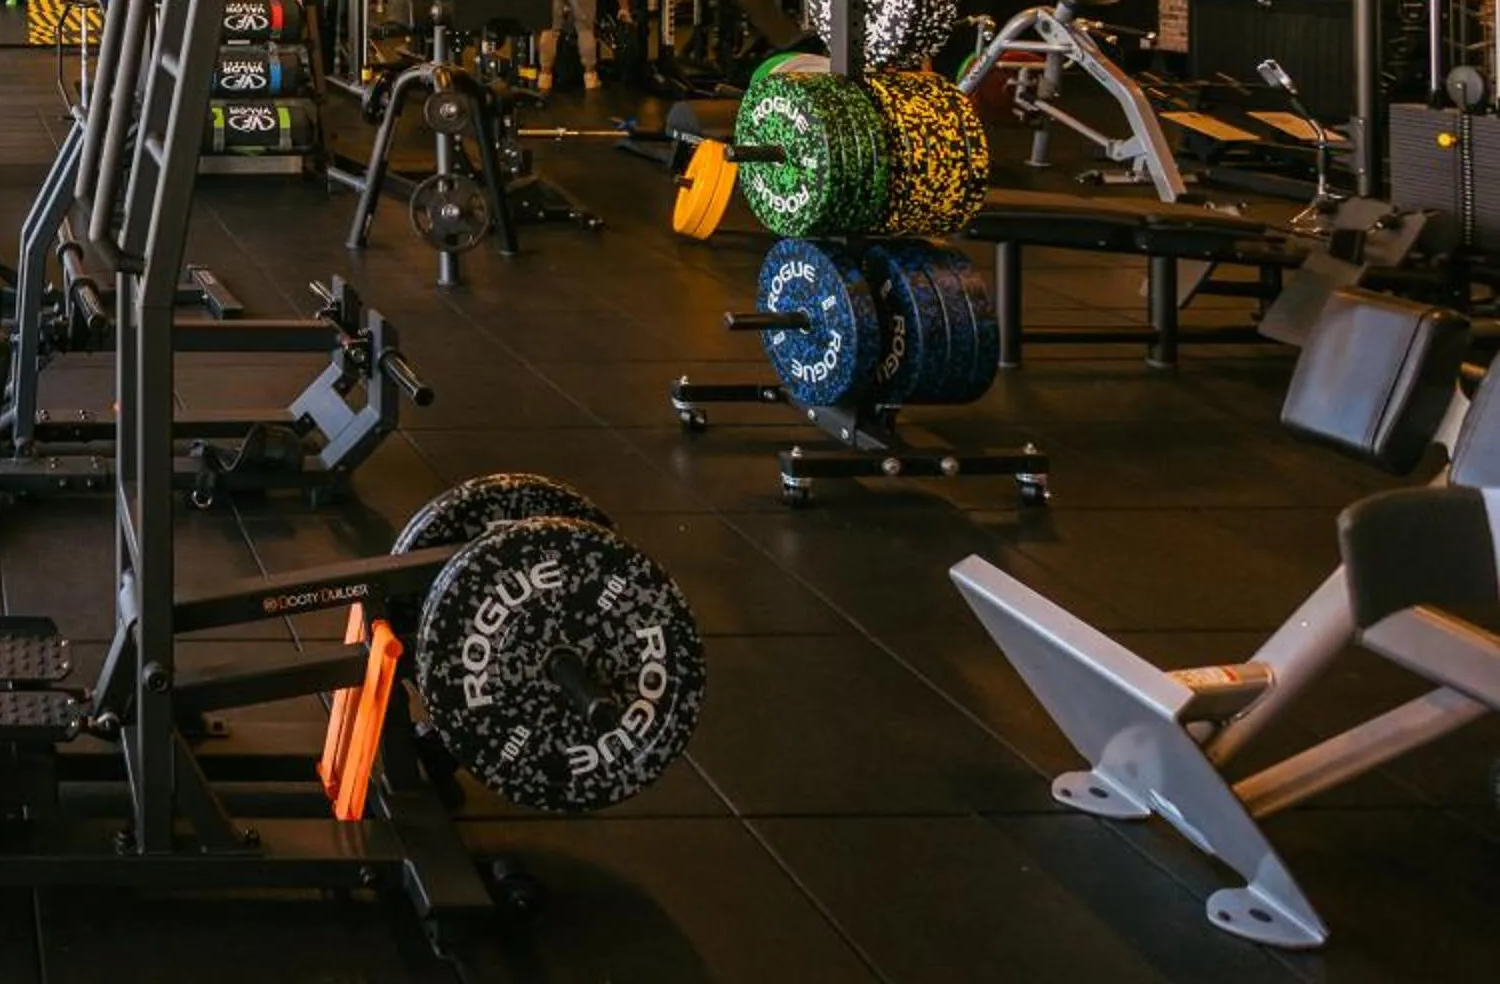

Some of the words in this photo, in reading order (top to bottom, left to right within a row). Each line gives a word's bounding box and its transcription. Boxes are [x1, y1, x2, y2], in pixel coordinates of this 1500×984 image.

[752, 96, 809, 134] ROGUE
[753, 173, 809, 213] ROGUE
[768, 261, 817, 313] ROGUE
[791, 329, 842, 383] ROGUE
[461, 559, 563, 709] ROGUE
[565, 625, 667, 776] ROGUE
